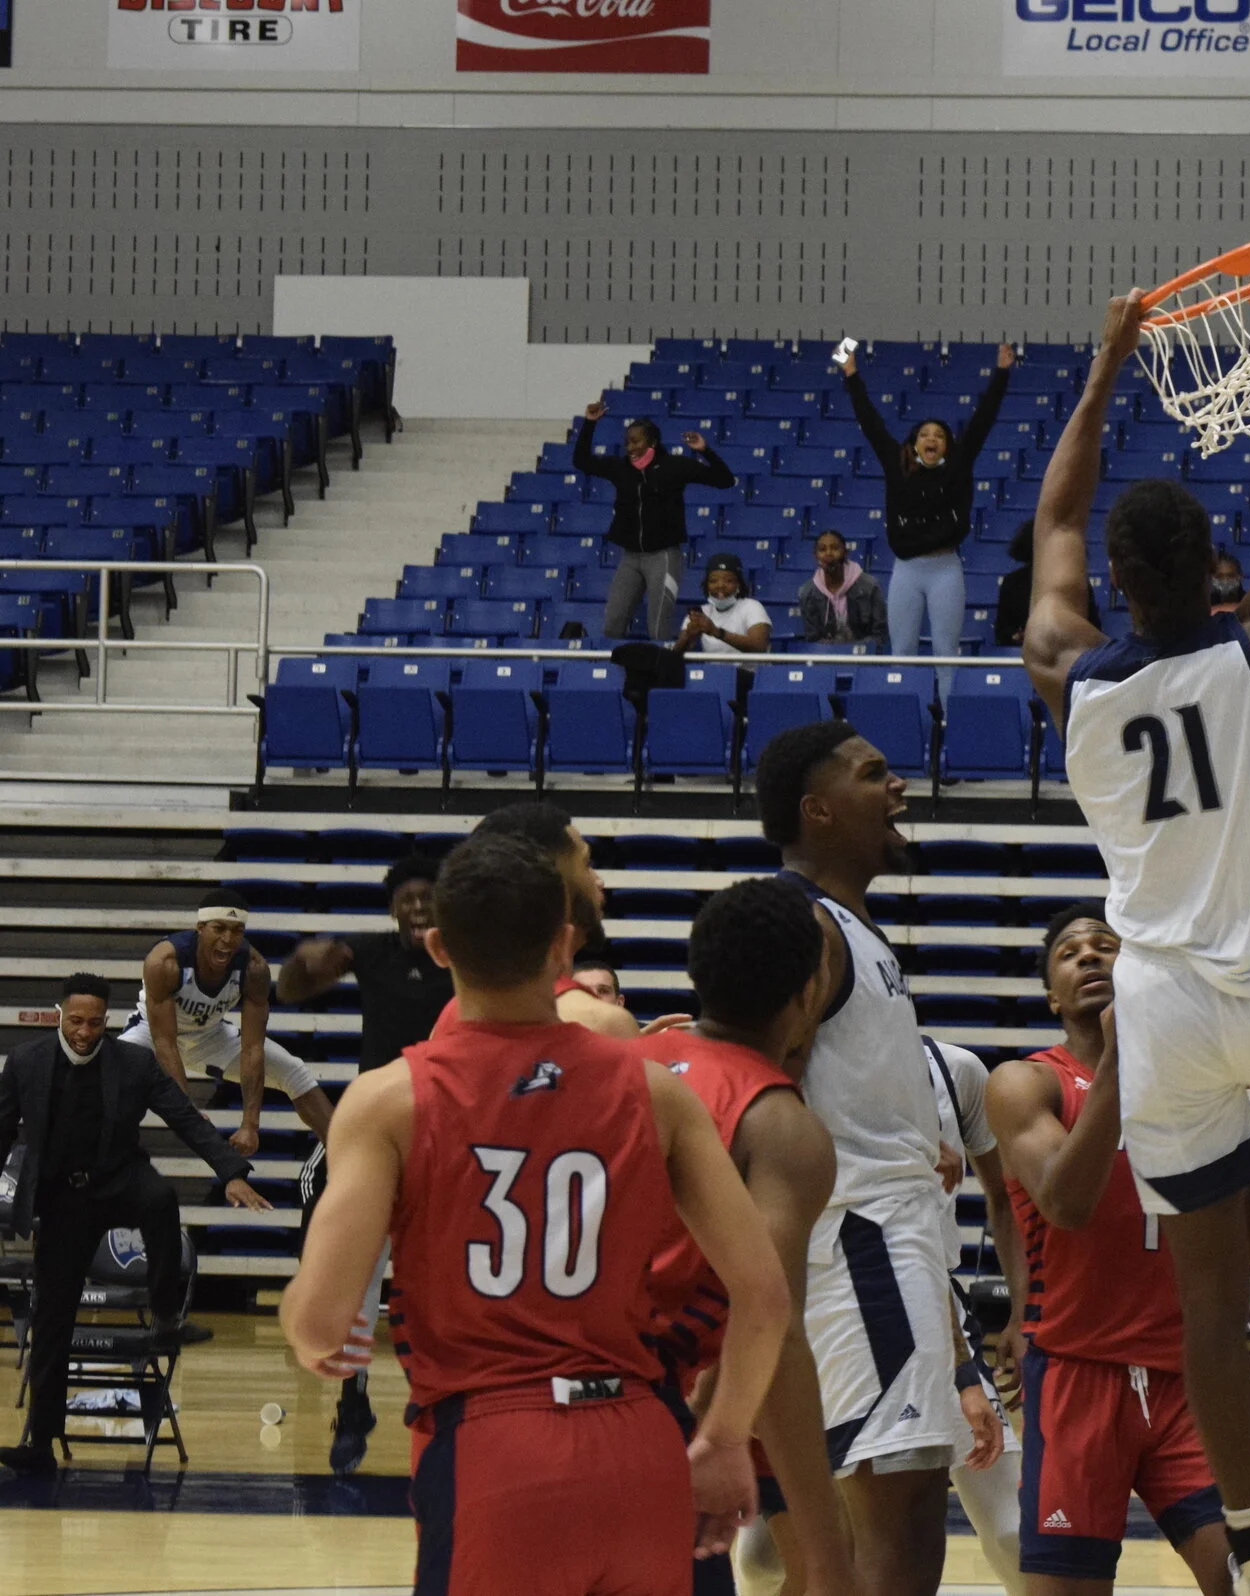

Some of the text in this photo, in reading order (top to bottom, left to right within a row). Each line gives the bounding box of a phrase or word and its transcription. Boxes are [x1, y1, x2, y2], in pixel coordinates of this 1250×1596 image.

[181, 19, 278, 41] TIRE
[1067, 28, 1250, 52] Local Office
[1120, 701, 1223, 824] 21
[466, 1144, 608, 1300] 30
